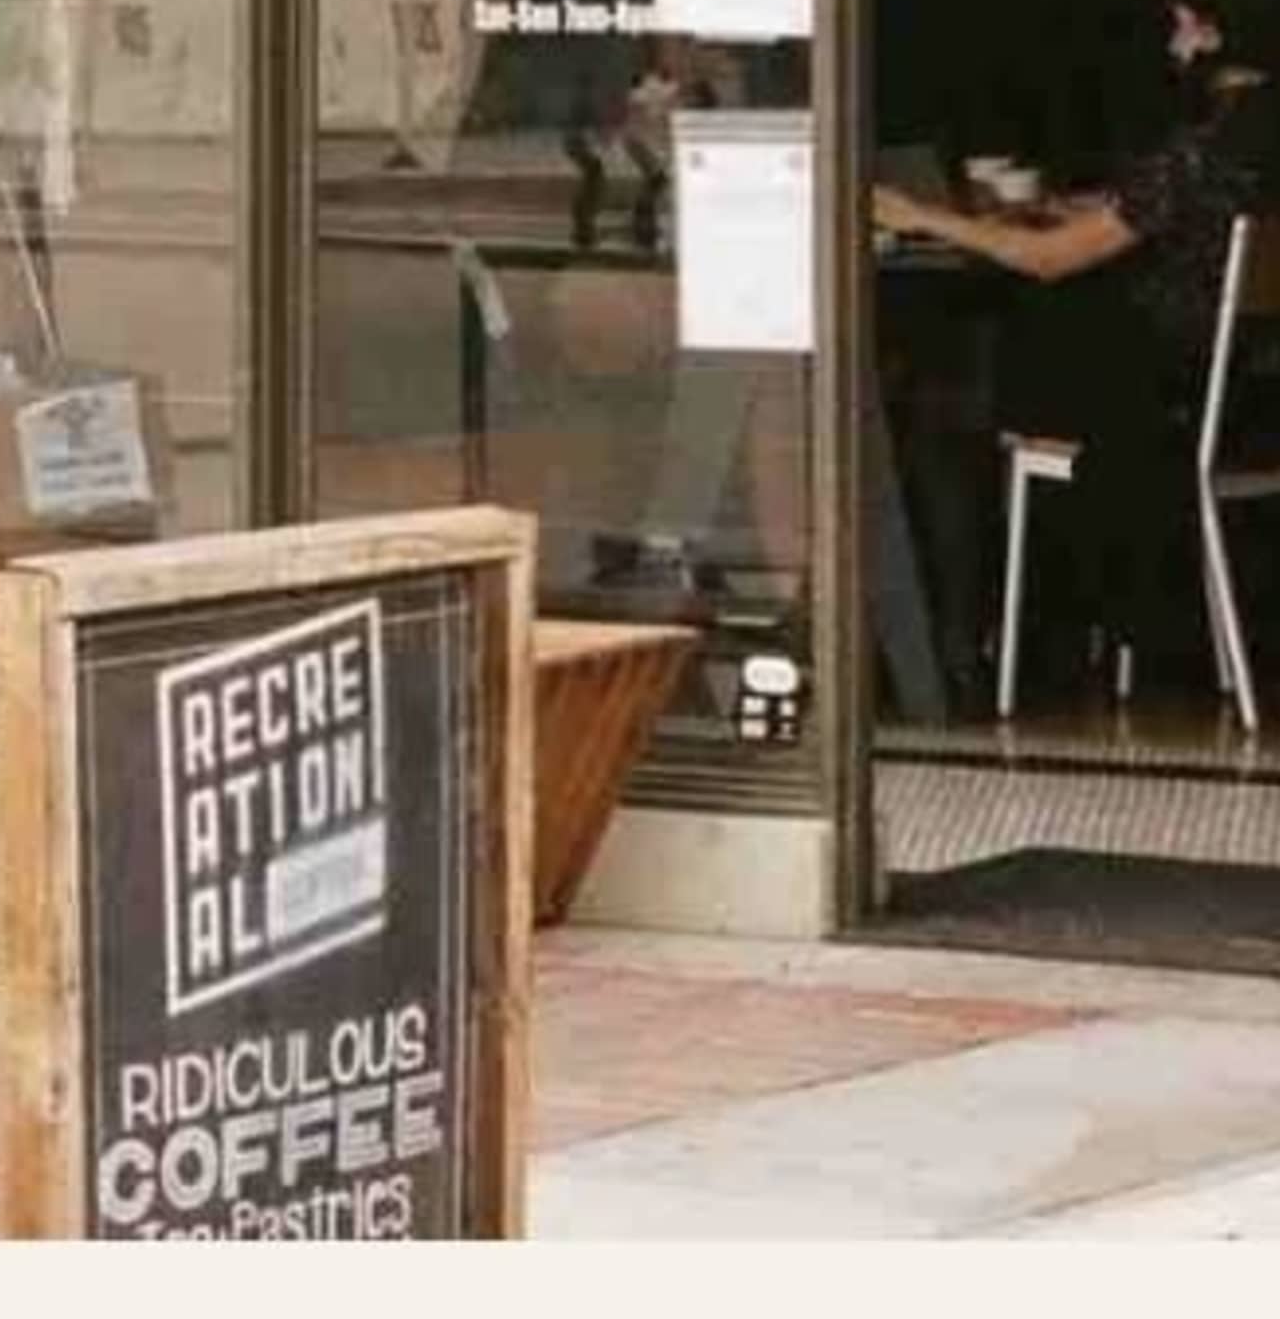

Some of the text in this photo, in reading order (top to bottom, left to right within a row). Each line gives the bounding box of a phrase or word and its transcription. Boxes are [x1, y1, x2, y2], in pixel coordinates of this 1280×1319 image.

[181, 636, 362, 778] RECRE
[184, 728, 365, 875] ATION
[188, 876, 262, 978] AL
[121, 1003, 427, 1131] RIDICULOUS
[97, 1069, 445, 1225] COFFEE
